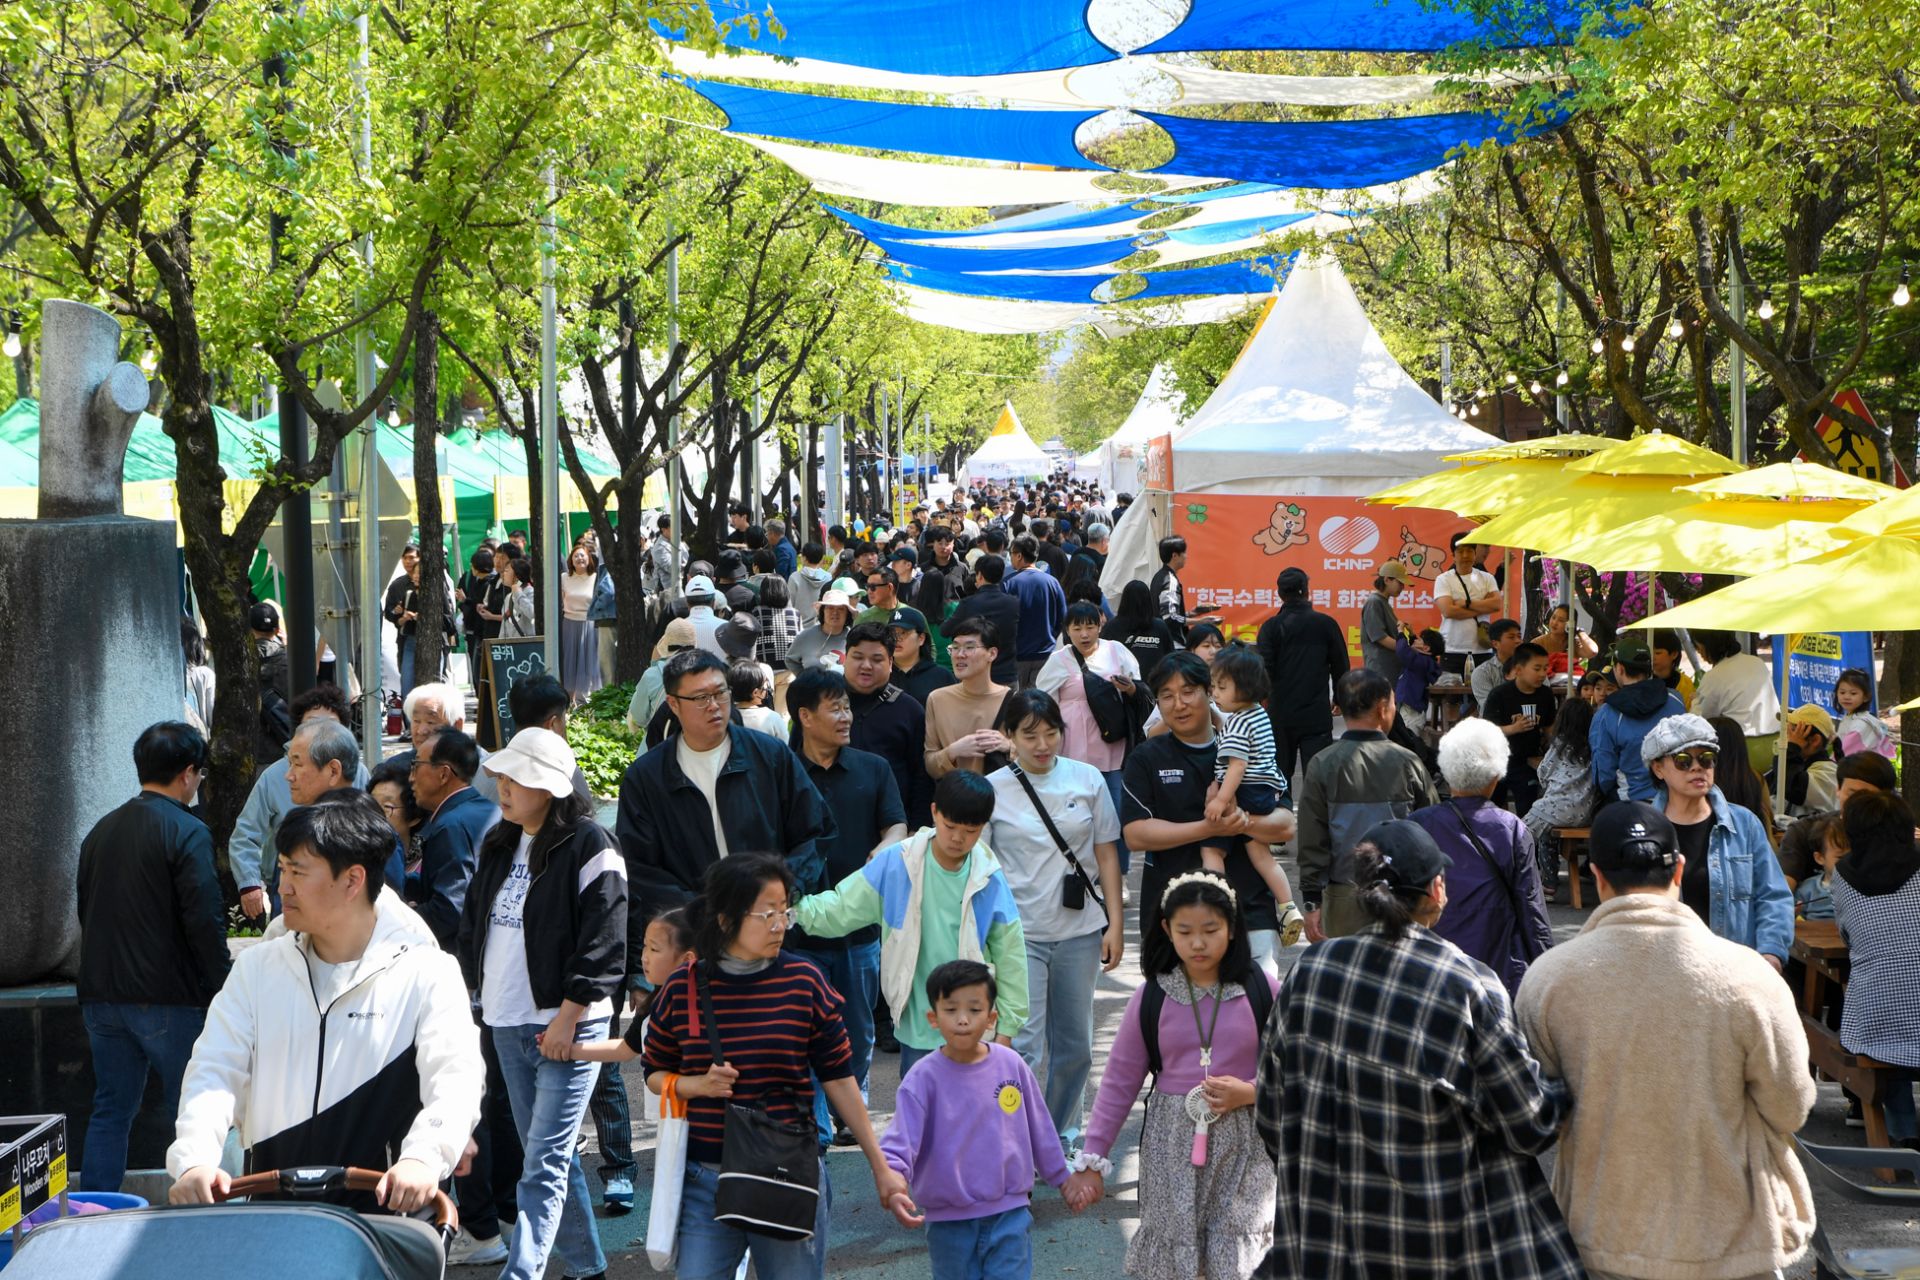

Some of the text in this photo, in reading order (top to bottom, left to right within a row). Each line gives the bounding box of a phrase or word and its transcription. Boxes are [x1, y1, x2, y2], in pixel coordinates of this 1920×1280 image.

[1323, 558, 1374, 570] KHNP
[1187, 587, 1434, 609] "한국수력력 화천전소
[22, 1140, 50, 1178] 나무꼬치
